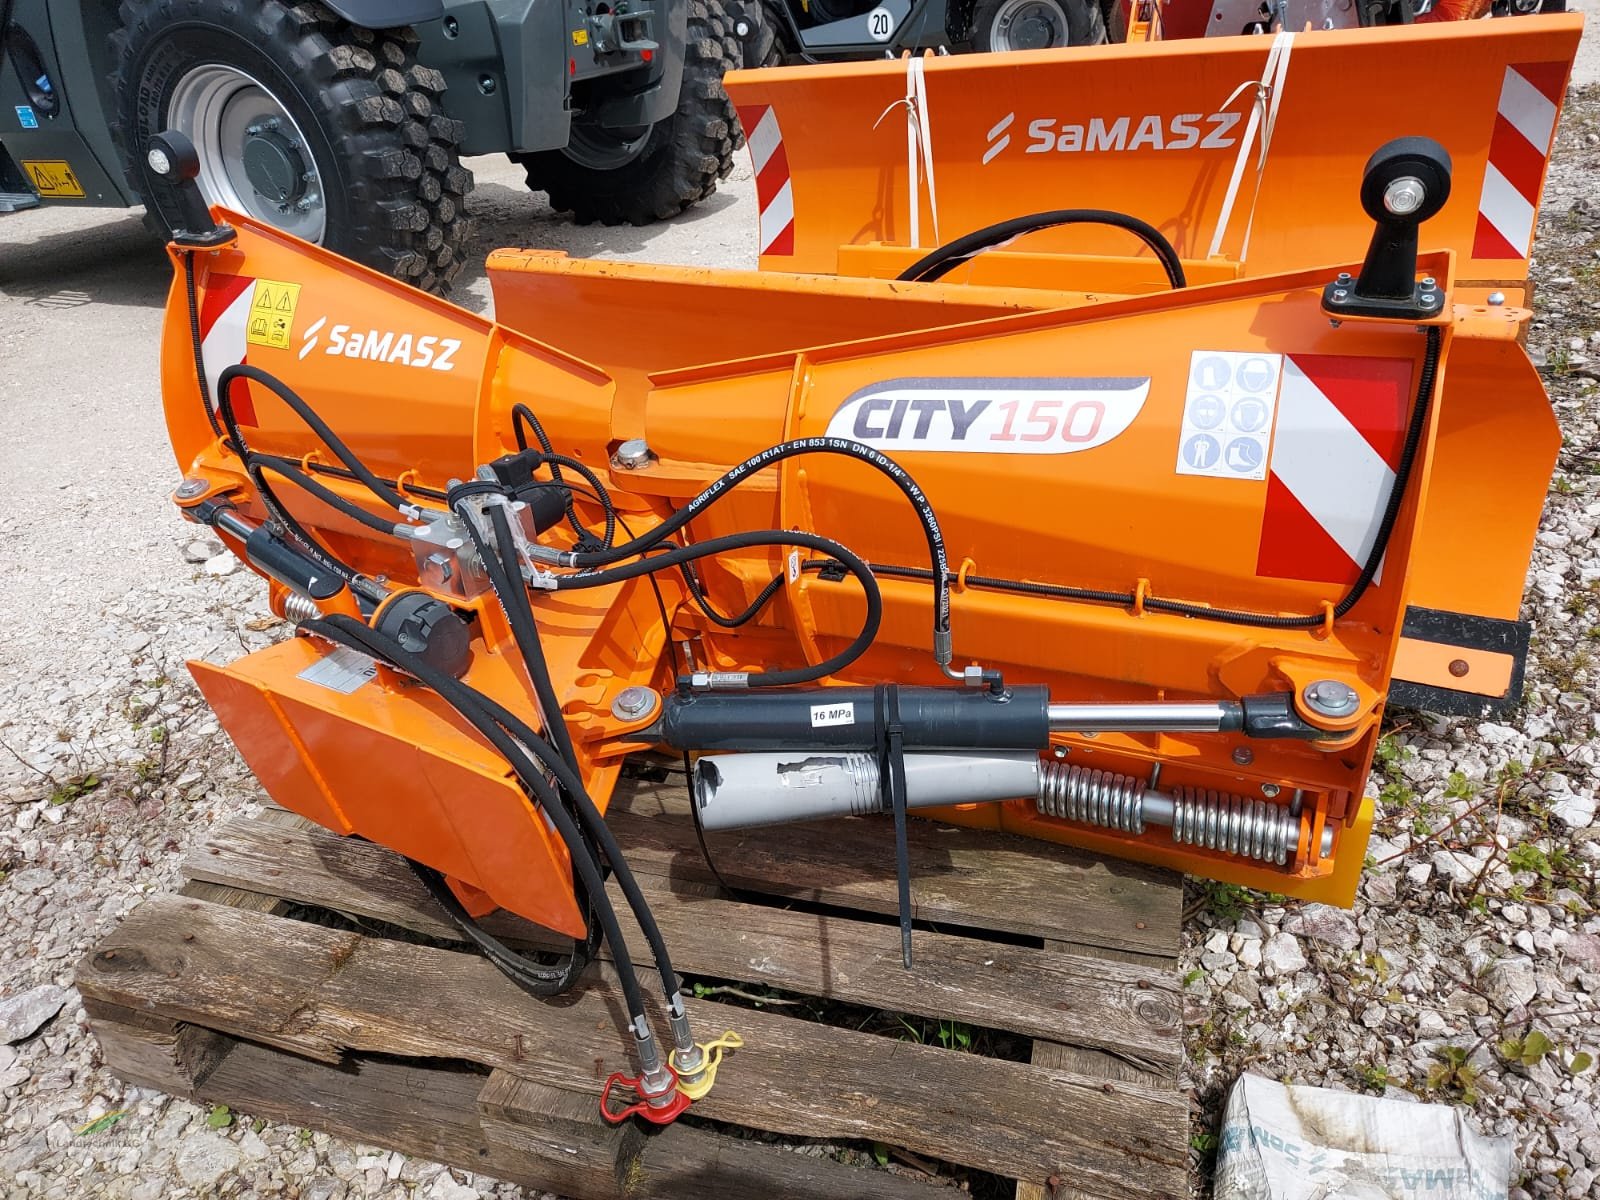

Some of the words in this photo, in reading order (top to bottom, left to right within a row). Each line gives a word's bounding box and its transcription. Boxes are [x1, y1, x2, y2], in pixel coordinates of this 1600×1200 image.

[873, 14, 888, 34] 20
[1025, 112, 1242, 153] SaMASZ
[325, 324, 462, 371] SaMASZ
[852, 398, 994, 441] CITY
[989, 400, 1107, 443] 150
[688, 480, 726, 513] AGRIFLEX
[728, 465, 747, 480] SAE
[747, 455, 762, 469] 100
[762, 445, 786, 461] R1AT
[793, 439, 807, 449] EN
[808, 438, 826, 447] 853
[828, 439, 848, 449] 1SN
[852, 443, 869, 456] DN
[868, 449, 875, 459] 6
[922, 506, 942, 543] 3260PSI
[813, 711, 826, 721] 16
[828, 709, 852, 719] MPa
